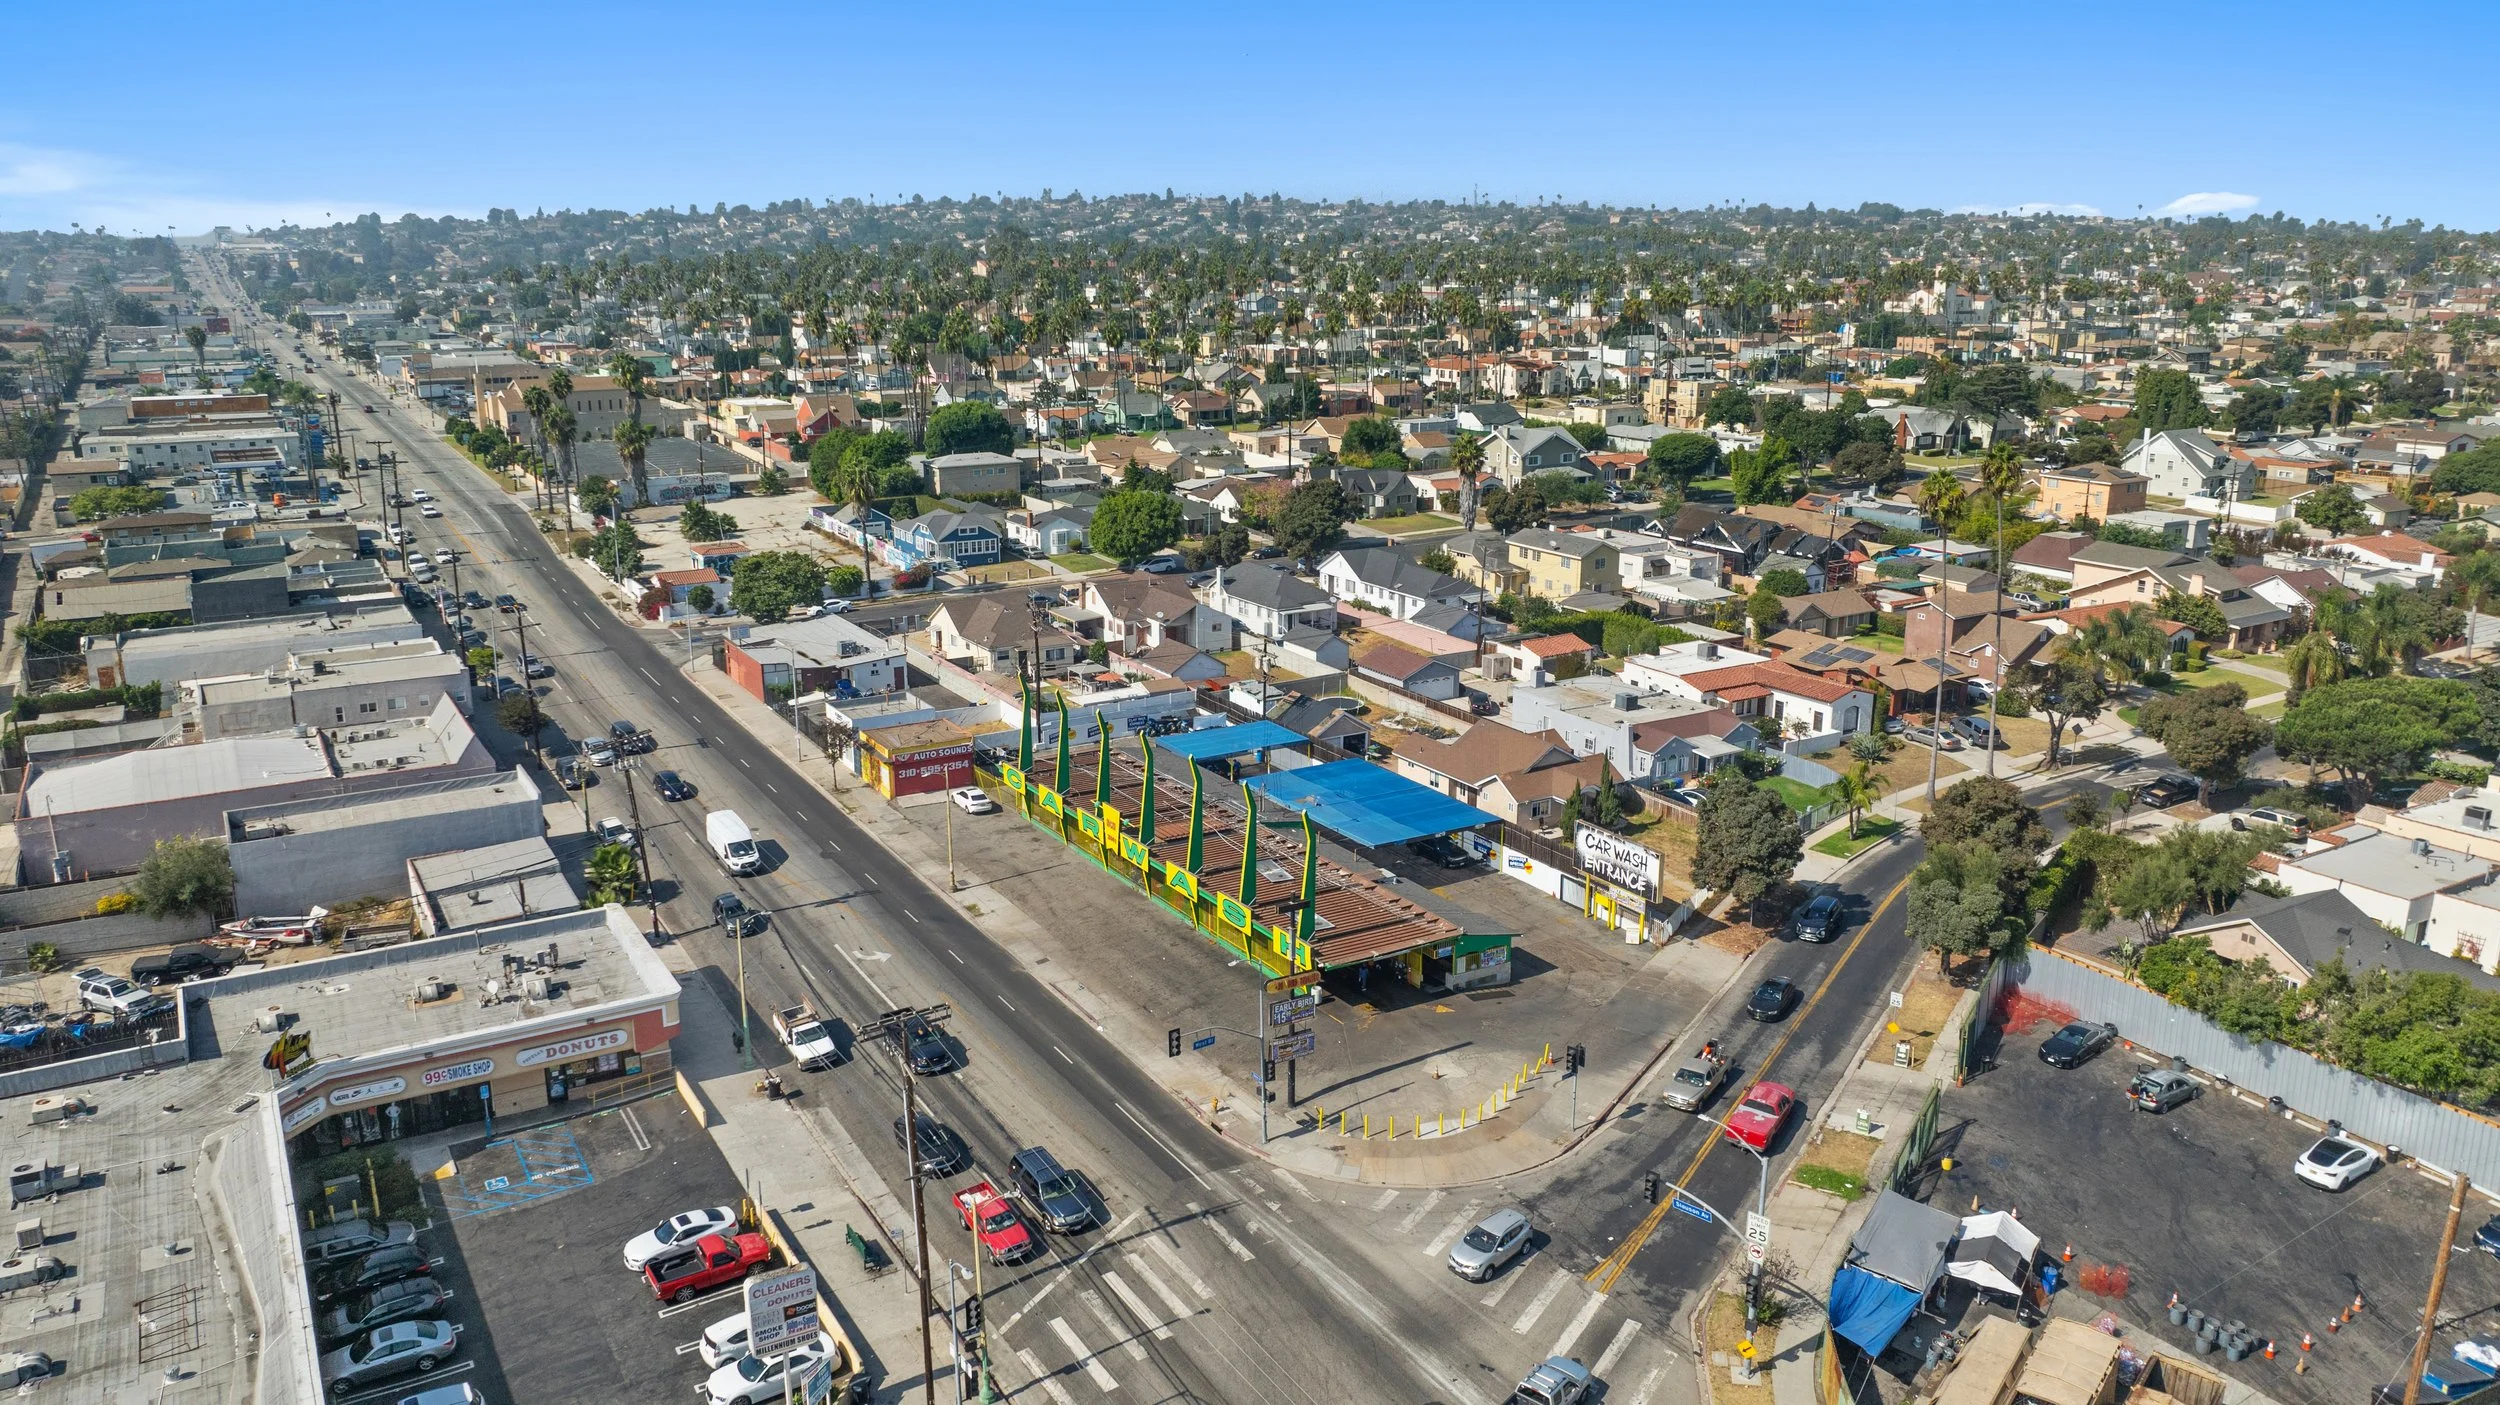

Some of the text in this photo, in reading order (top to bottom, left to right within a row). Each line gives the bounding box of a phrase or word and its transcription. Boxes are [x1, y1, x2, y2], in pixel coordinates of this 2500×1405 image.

[914, 751, 937, 761] AUTO
[938, 745, 973, 757] SOUNDS
[1585, 834, 1648, 872] CAR WASH
[1007, 768, 1306, 967] CAR WASH
[1584, 857, 1647, 891] ENTRANCE
[1274, 1002, 1297, 1013] EARLY
[1298, 997, 1314, 1009] BIRD
[545, 1034, 619, 1058] DONUTS
[447, 1065, 471, 1080] SMOKE
[472, 1061, 491, 1075] SHOP
[531, 1164, 580, 1181] NO PARKING
[1675, 1201, 1709, 1219] Slauson Av
[1750, 1214, 1768, 1226] SPEED
[1751, 1221, 1766, 1229] LIMIT
[1749, 1227, 1766, 1242] 25
[753, 1275, 811, 1299] CLEANERS
[767, 1288, 813, 1307] DONUTS
[755, 1324, 784, 1337] SMOKE
[758, 1331, 780, 1343] SHOP
[756, 1331, 818, 1356] MILLENNIUM SHOES
